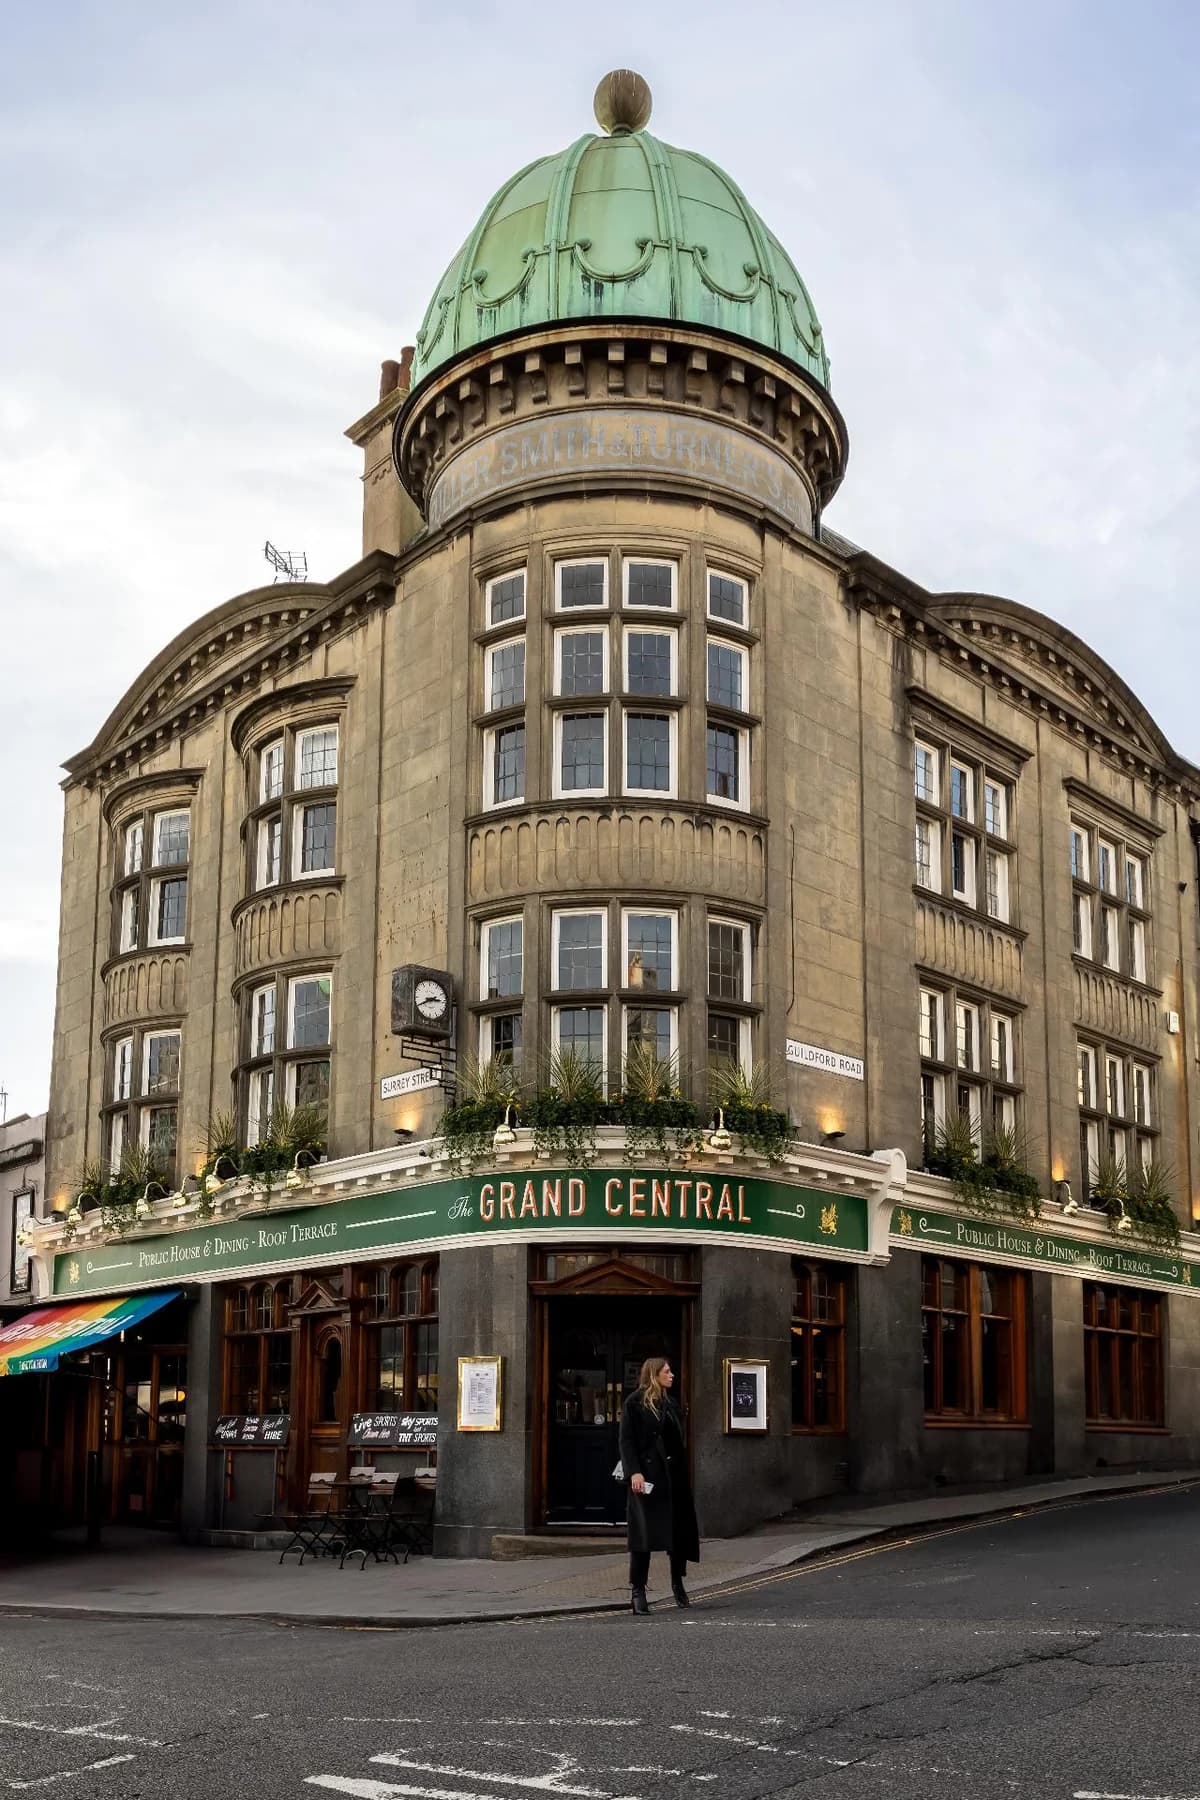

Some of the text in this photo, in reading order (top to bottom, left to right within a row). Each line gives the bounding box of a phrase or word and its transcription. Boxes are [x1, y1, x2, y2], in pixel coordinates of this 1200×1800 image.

[610, 432, 627, 457] &
[788, 1045, 862, 1074] GUILDFORD ROAD
[383, 1077, 411, 1093] SURREY
[447, 1177, 752, 1224] The GRAND CENTRAL
[138, 1250, 169, 1268] PUBLIC
[170, 1244, 201, 1262] HOUSE
[203, 1241, 213, 1257] &
[214, 1237, 249, 1254] DINING
[258, 1229, 287, 1248] ROOF
[291, 1222, 338, 1242] TERRACE
[957, 1223, 995, 1247] PUBLIC
[998, 1231, 1032, 1253] HOUSE
[1034, 1238, 1044, 1255] &
[1047, 1240, 1081, 1262] DINING
[1089, 1248, 1114, 1268] ROOF
[1116, 1253, 1152, 1275] TERRACE
[353, 1415, 398, 1433] Live SPORTS
[415, 1417, 439, 1426] SPORTS
[399, 1432, 437, 1443] TNT SPORTS
